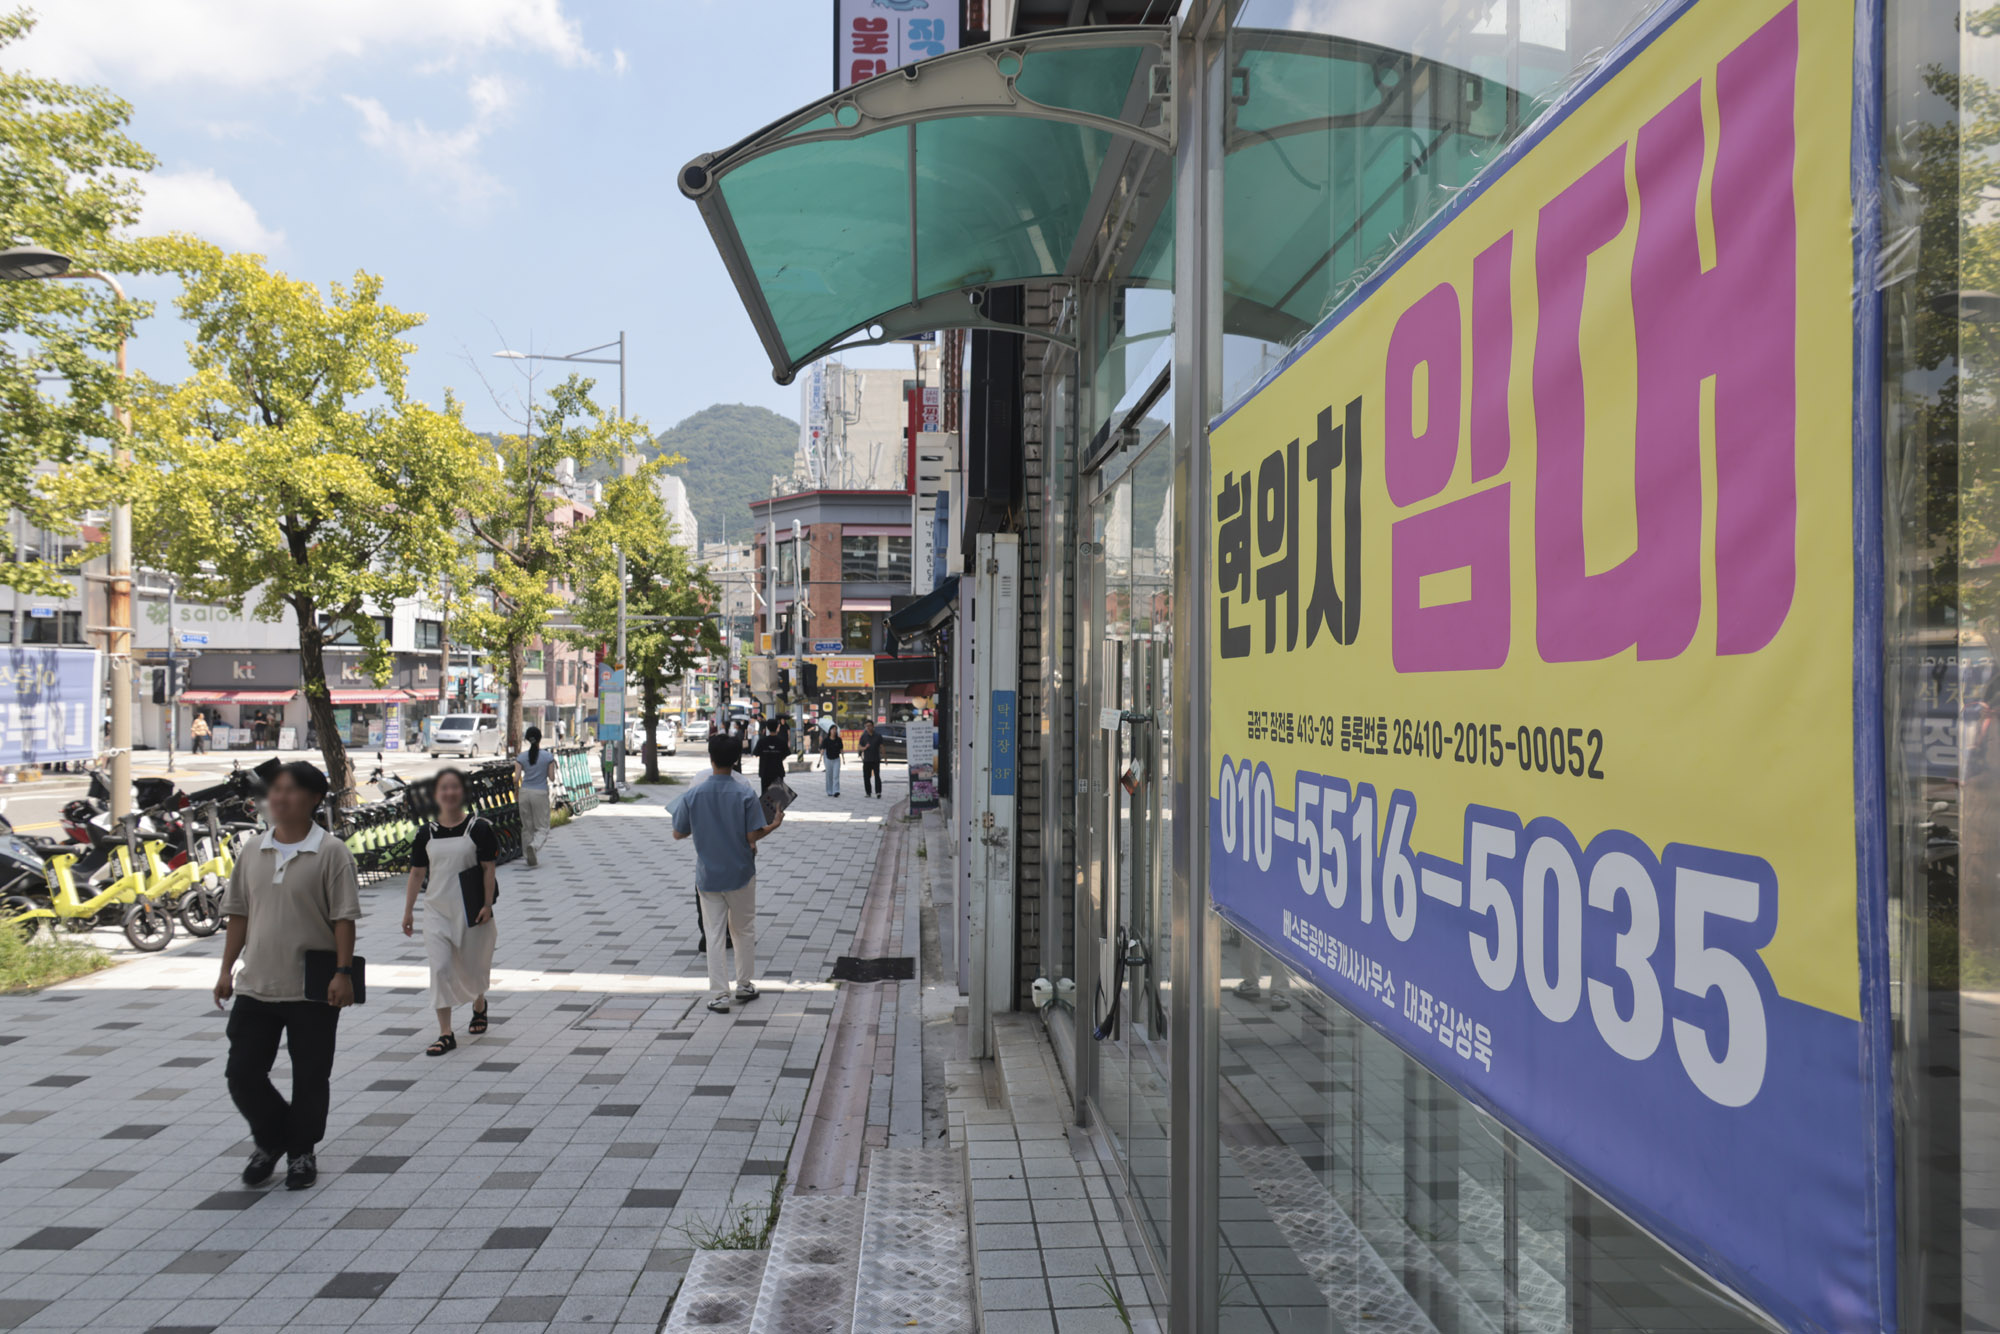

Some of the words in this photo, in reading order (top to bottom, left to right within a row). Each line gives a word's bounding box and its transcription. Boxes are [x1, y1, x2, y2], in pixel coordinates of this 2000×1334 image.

[1217, 395, 1362, 659] 현위치
[1384, 0, 1797, 673] 임대
[233, 661, 256, 679] kt
[341, 661, 363, 680] kt
[826, 669, 864, 683] SALE
[996, 703, 1011, 754] 탁구장
[1247, 710, 1268, 740] 금정구
[1270, 711, 1294, 744] 장전동
[1297, 714, 1334, 747] 413-29
[1340, 715, 1388, 755] 등록번호
[1393, 718, 1604, 780] 26410-2015-00052
[994, 768, 1012, 780] 3F
[1220, 763, 1767, 1107] 010-5516-5035
[1283, 908, 1396, 1009] 베스트공인중개사사무소
[1403, 980, 1493, 1073] 대표:김성욱
